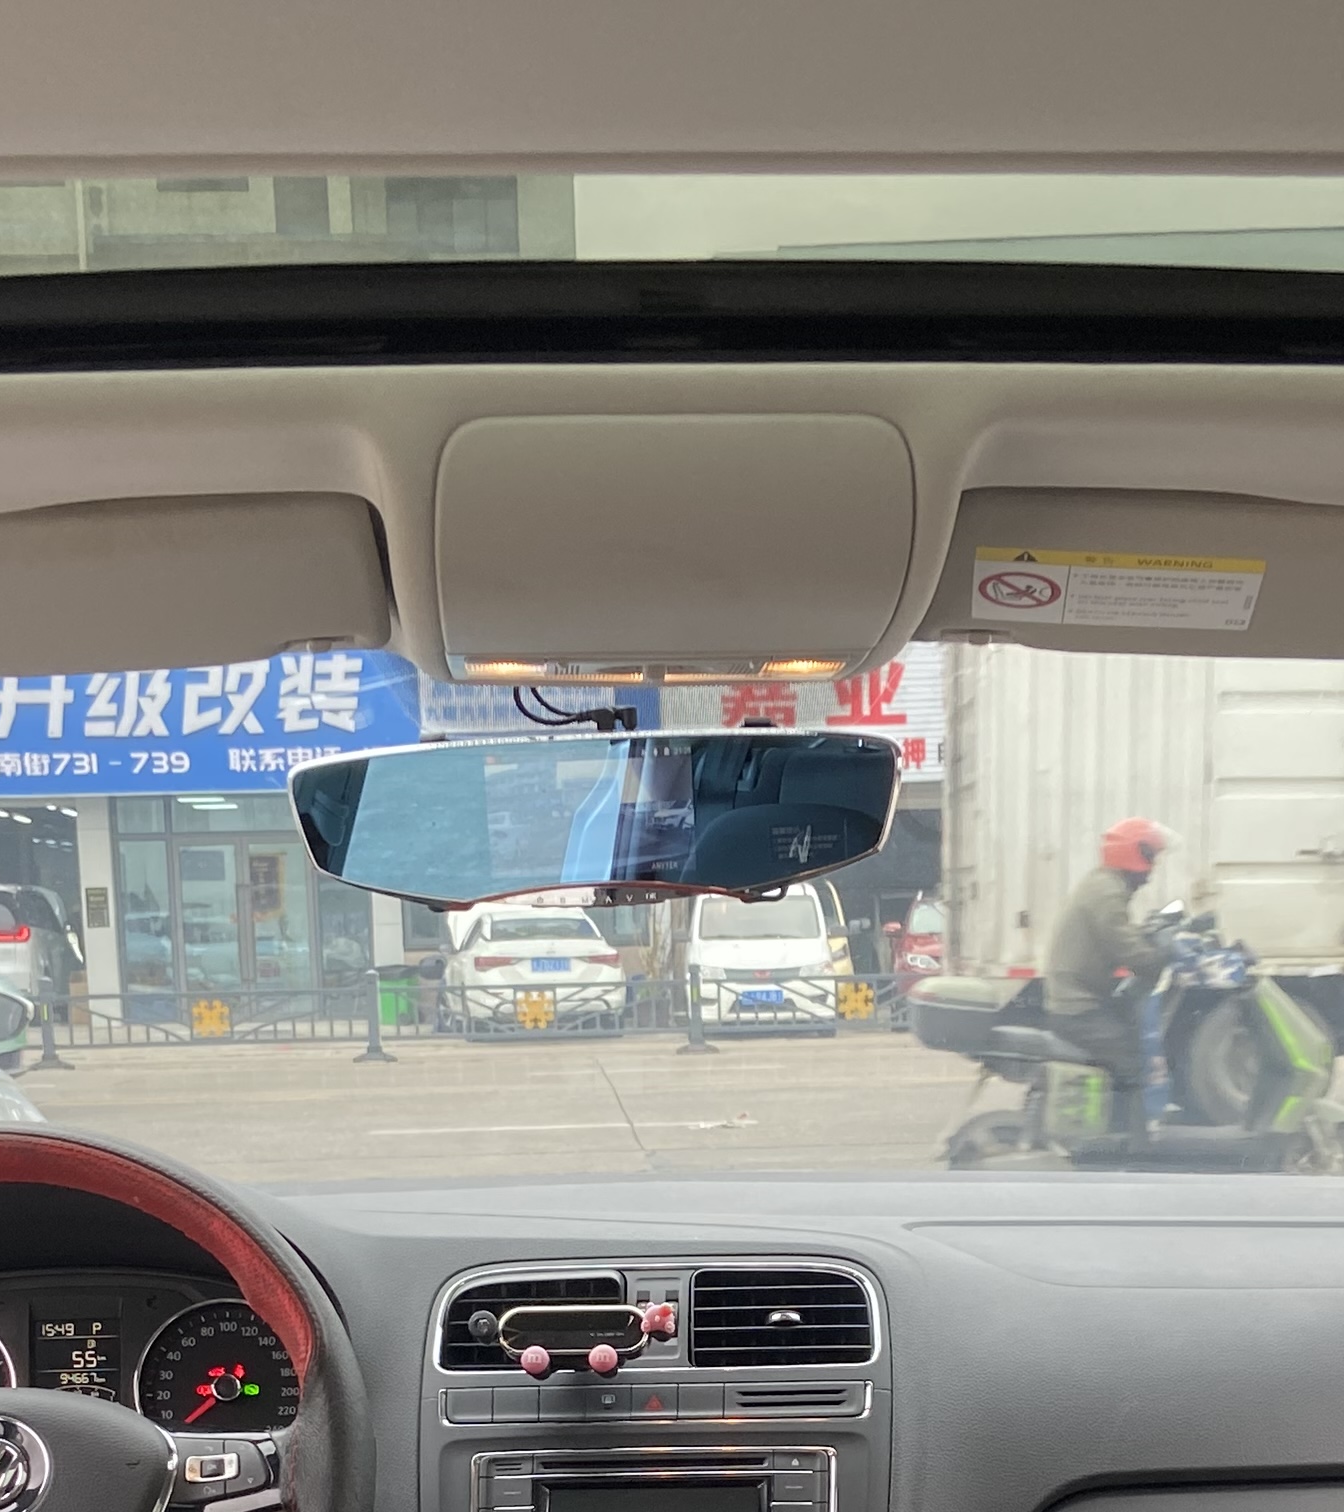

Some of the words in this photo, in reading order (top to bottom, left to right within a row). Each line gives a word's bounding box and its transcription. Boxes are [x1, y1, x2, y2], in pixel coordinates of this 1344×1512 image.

[1137, 557, 1214, 569] WARNING
[93, 1322, 102, 1335] P
[201, 1327, 214, 1337] 80
[219, 1322, 237, 1332] 100
[241, 1327, 258, 1337] 120
[182, 1337, 196, 1347] 60
[258, 1336, 276, 1346] 140
[72, 1351, 97, 1368] 55
[167, 1352, 181, 1361] 40
[272, 1351, 289, 1360] 160
[160, 1370, 173, 1380] 30
[157, 1390, 171, 1400] 20
[281, 1387, 299, 1396] 200
[161, 1410, 173, 1420] 10
[278, 1406, 296, 1415] 220
